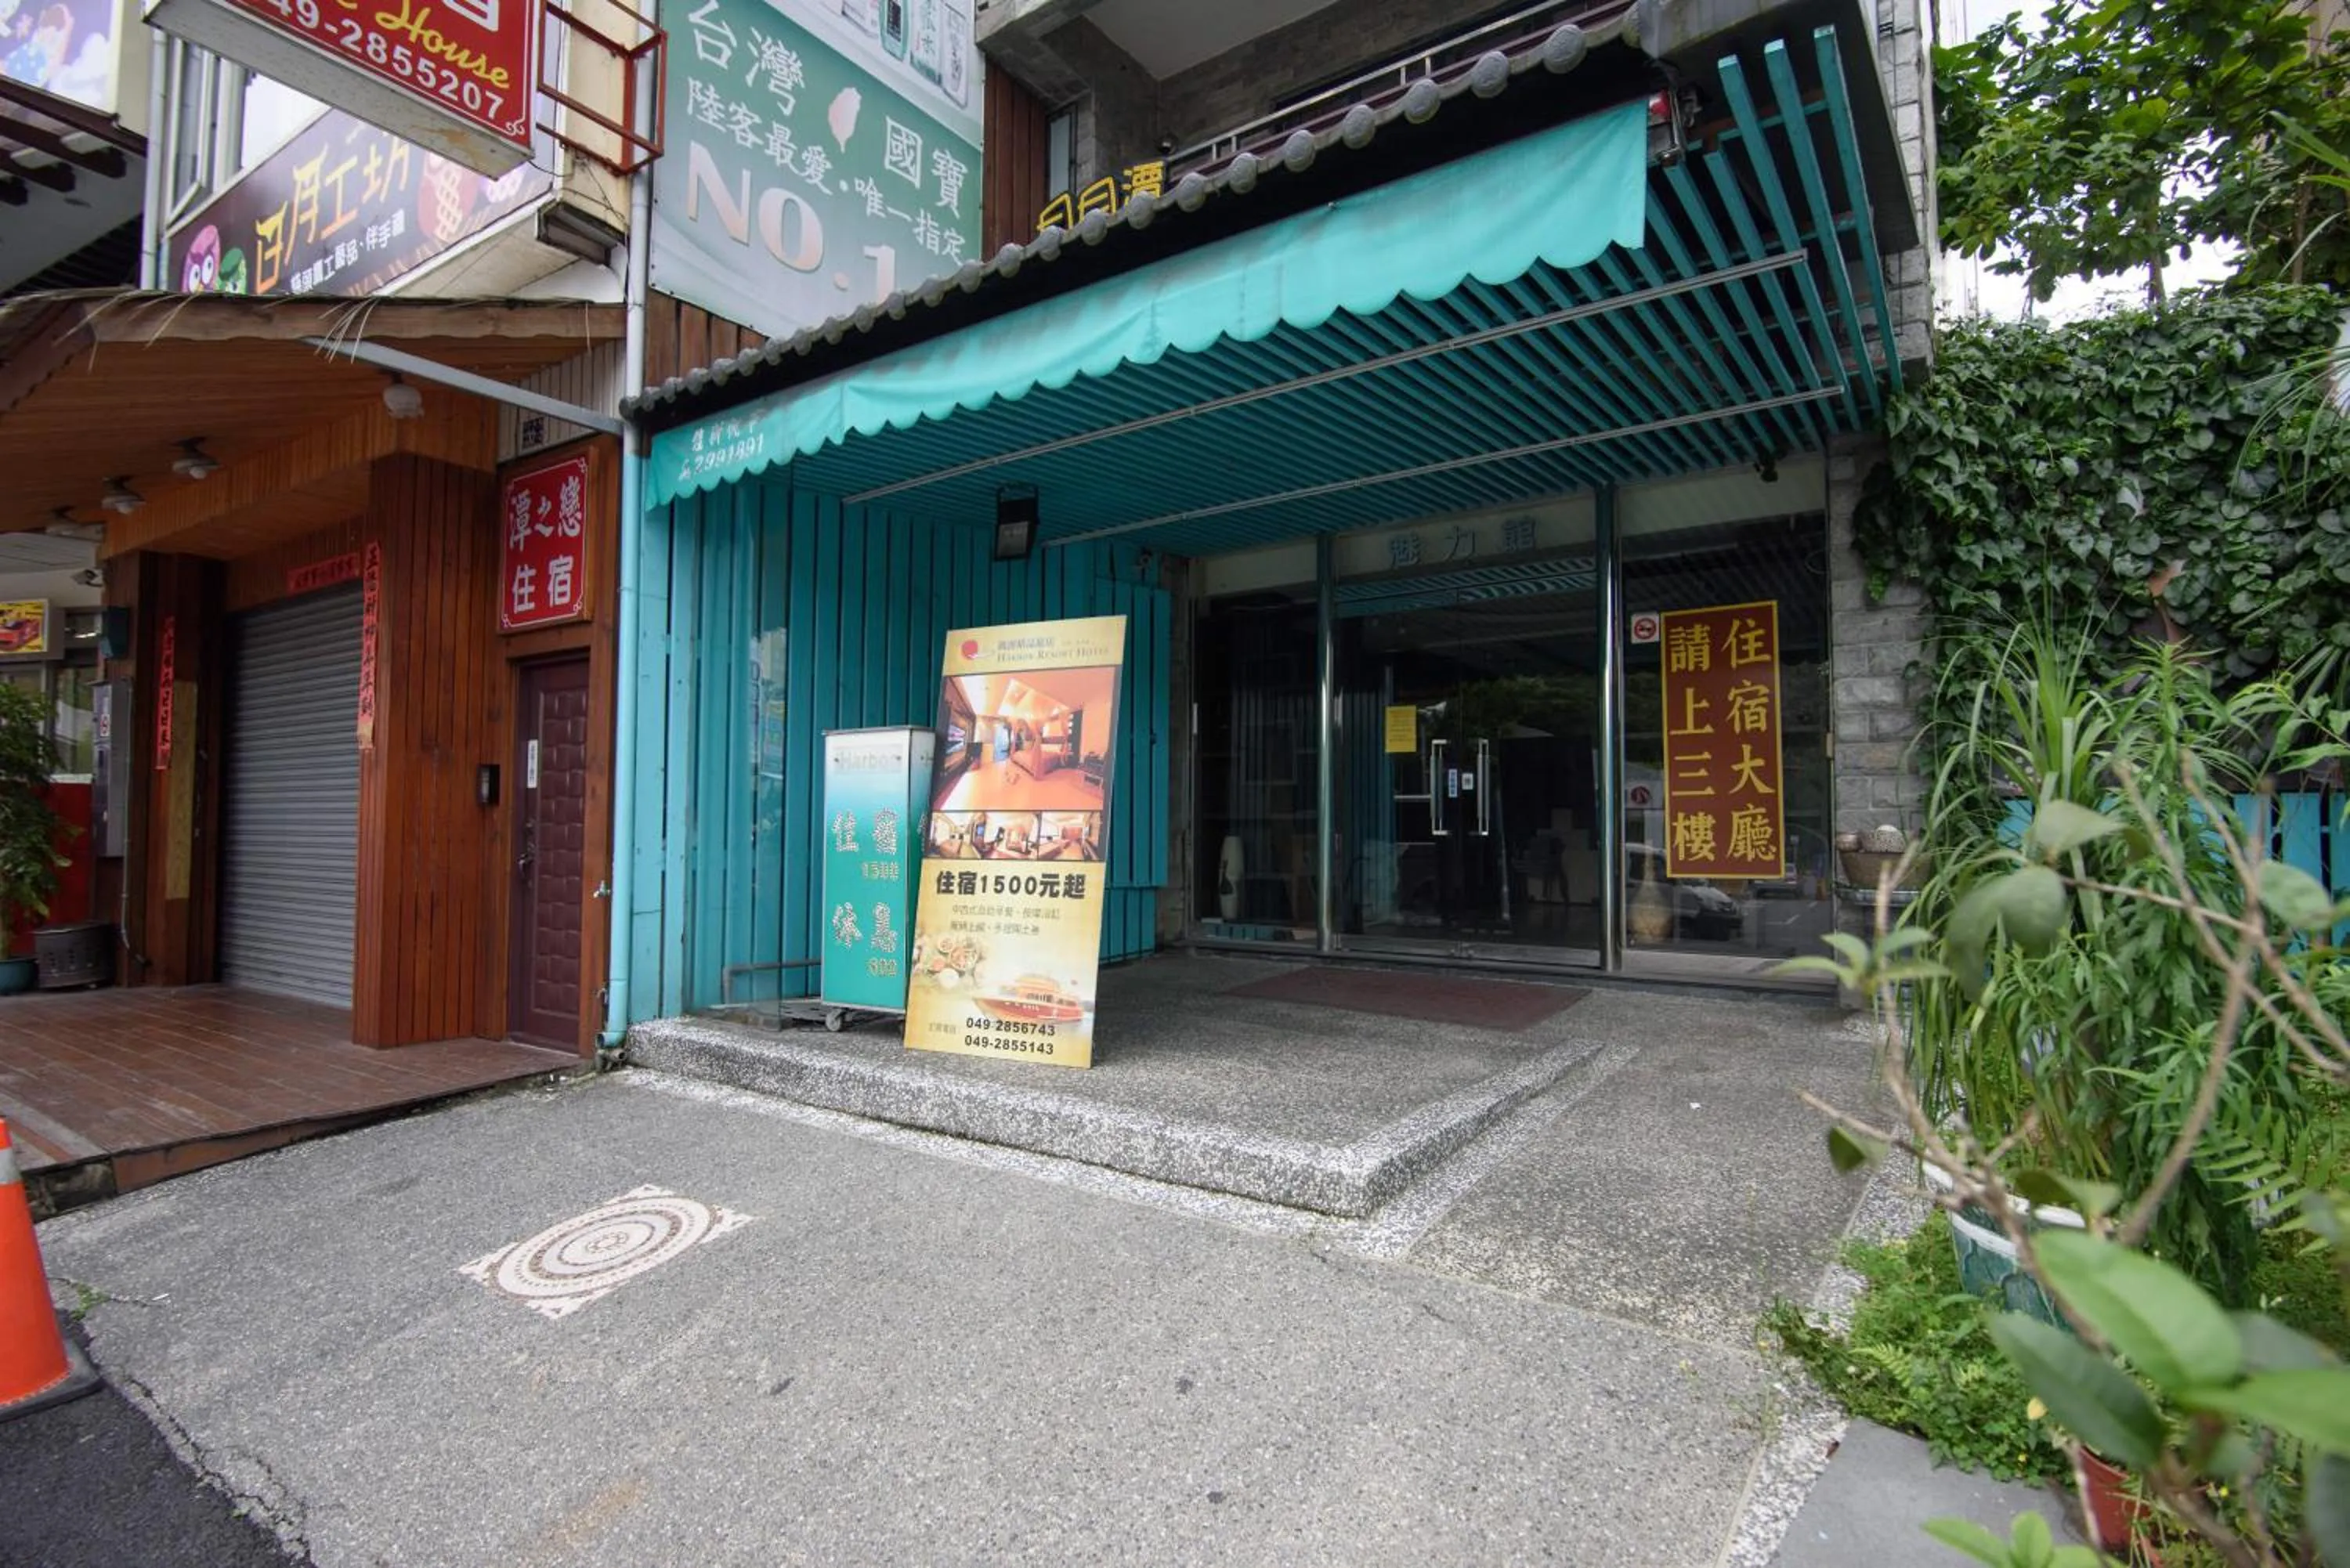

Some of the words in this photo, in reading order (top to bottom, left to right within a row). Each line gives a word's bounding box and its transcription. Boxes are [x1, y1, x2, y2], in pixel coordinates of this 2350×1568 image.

[375, 0, 510, 89] House
[688, 0, 805, 117] 台灣
[884, 115, 968, 219] 國寶
[509, 475, 582, 551] 潭之戀
[512, 555, 575, 614] 住宿
[1668, 623, 1717, 862] 請上三樓
[1721, 617, 1777, 862] 住宿大廳
[936, 870, 1086, 900] 住宿1500元起
[964, 1035, 1054, 1056] 049-2855143
